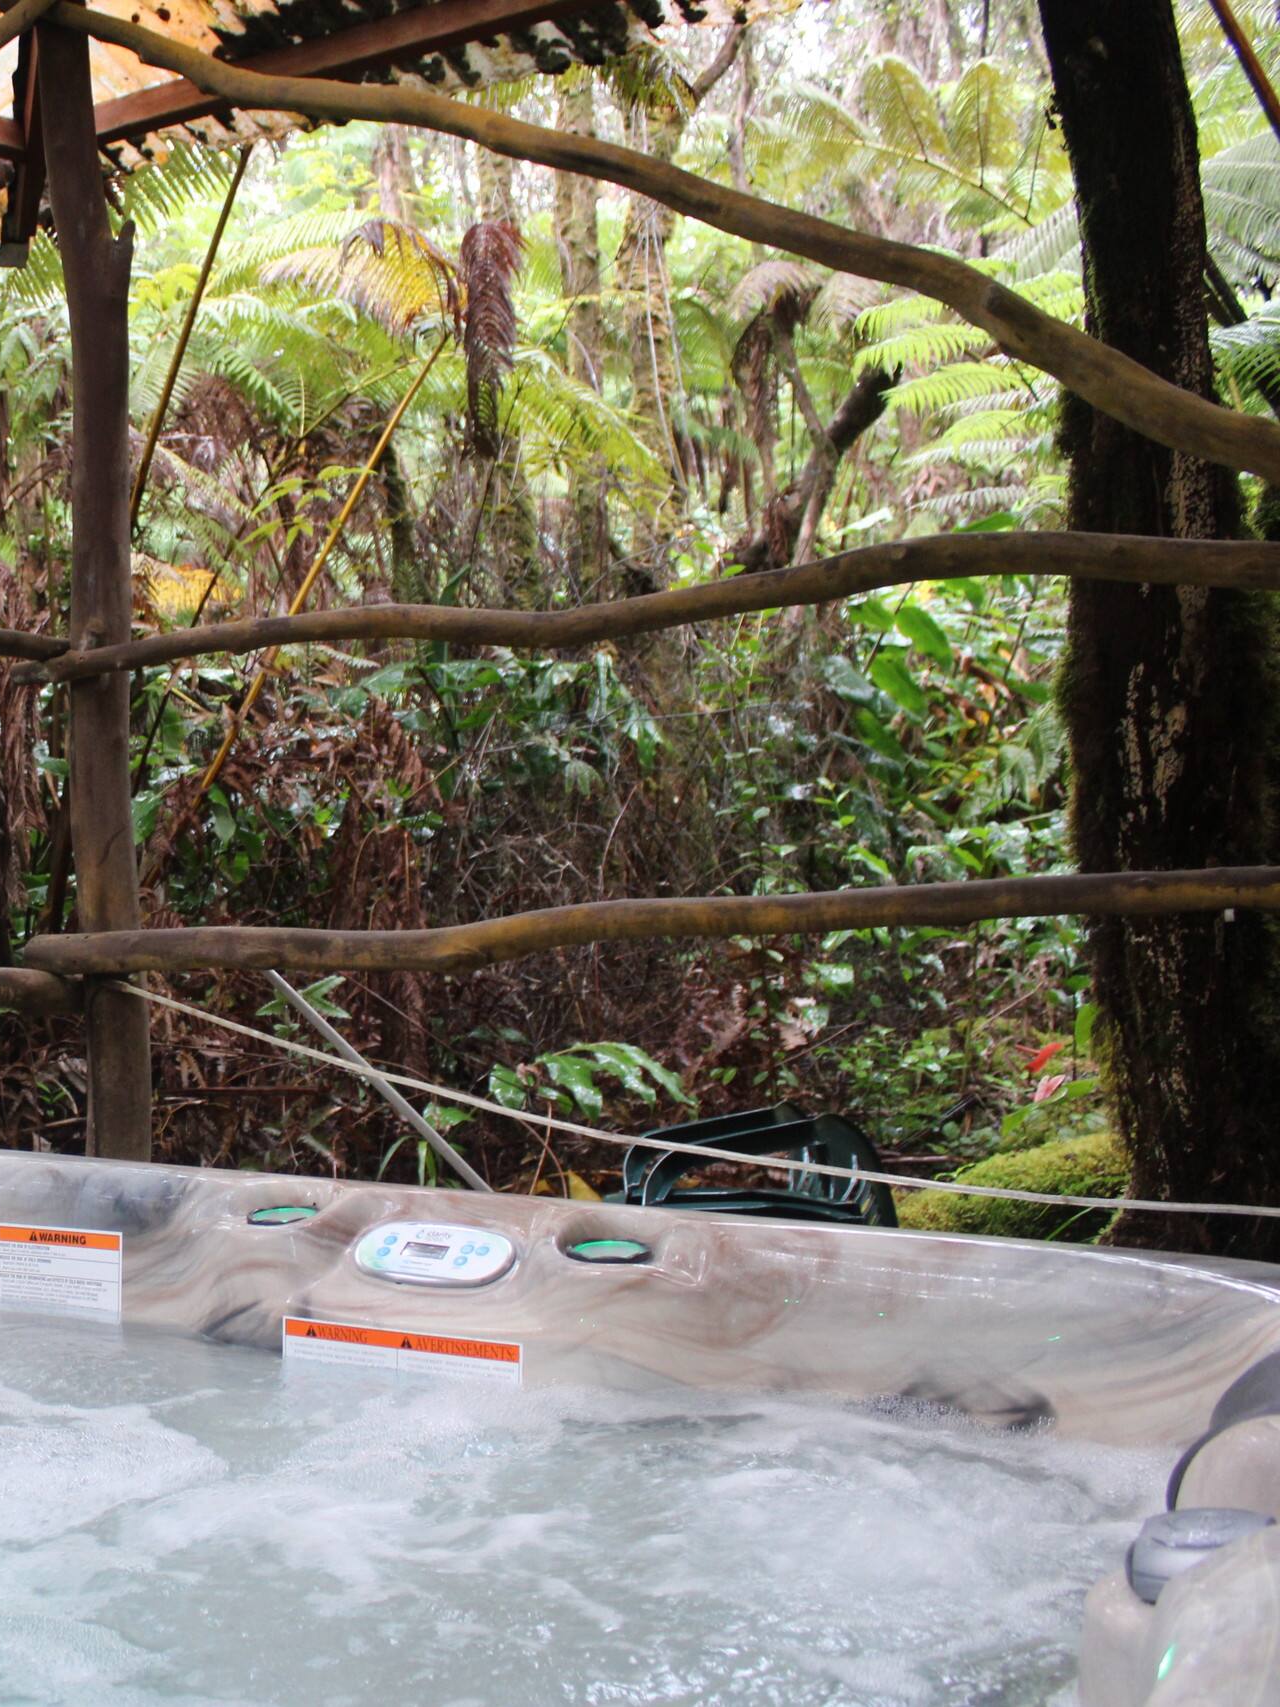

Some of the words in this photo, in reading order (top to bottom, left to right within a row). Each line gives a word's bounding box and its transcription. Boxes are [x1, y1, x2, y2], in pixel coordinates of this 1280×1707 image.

[39, 1232, 86, 1245] WARNING
[317, 1325, 367, 1343] WARNING
[416, 1338, 513, 1360] AVERTISSEMENTS
